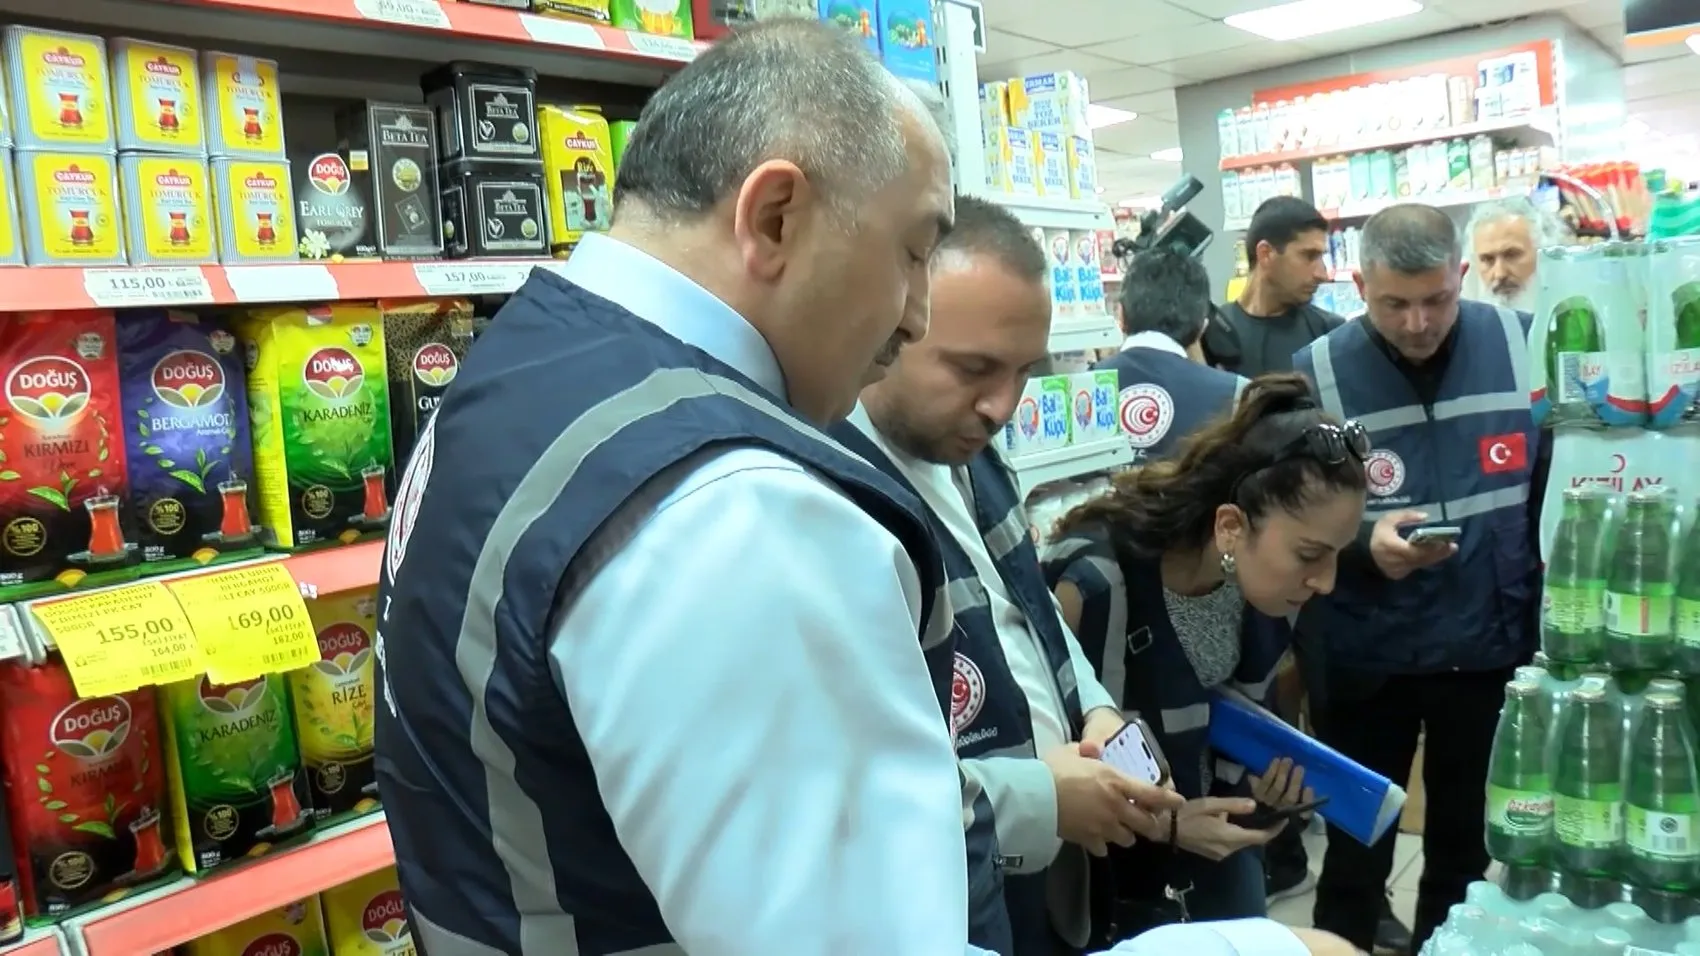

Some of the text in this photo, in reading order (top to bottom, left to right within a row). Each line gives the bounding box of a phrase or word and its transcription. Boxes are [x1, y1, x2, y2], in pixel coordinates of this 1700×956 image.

[383, 129, 427, 143] BETA TEA
[110, 276, 166, 292] 115,00
[445, 271, 486, 284] 157,00
[20, 369, 78, 390] DOĞUŞ
[163, 362, 214, 381] DOĞUŞ
[1042, 393, 1057, 415] Bal
[1095, 387, 1108, 407] Bal
[152, 413, 230, 431] BERGAMOT
[303, 402, 373, 422] KARADENİZ
[24, 440, 90, 458] KIRMIZI
[96, 617, 174, 645] 155,00
[320, 631, 363, 652] DOĞUŞ
[64, 705, 121, 733] DOĞUŞ
[368, 899, 404, 922] DOĞU
